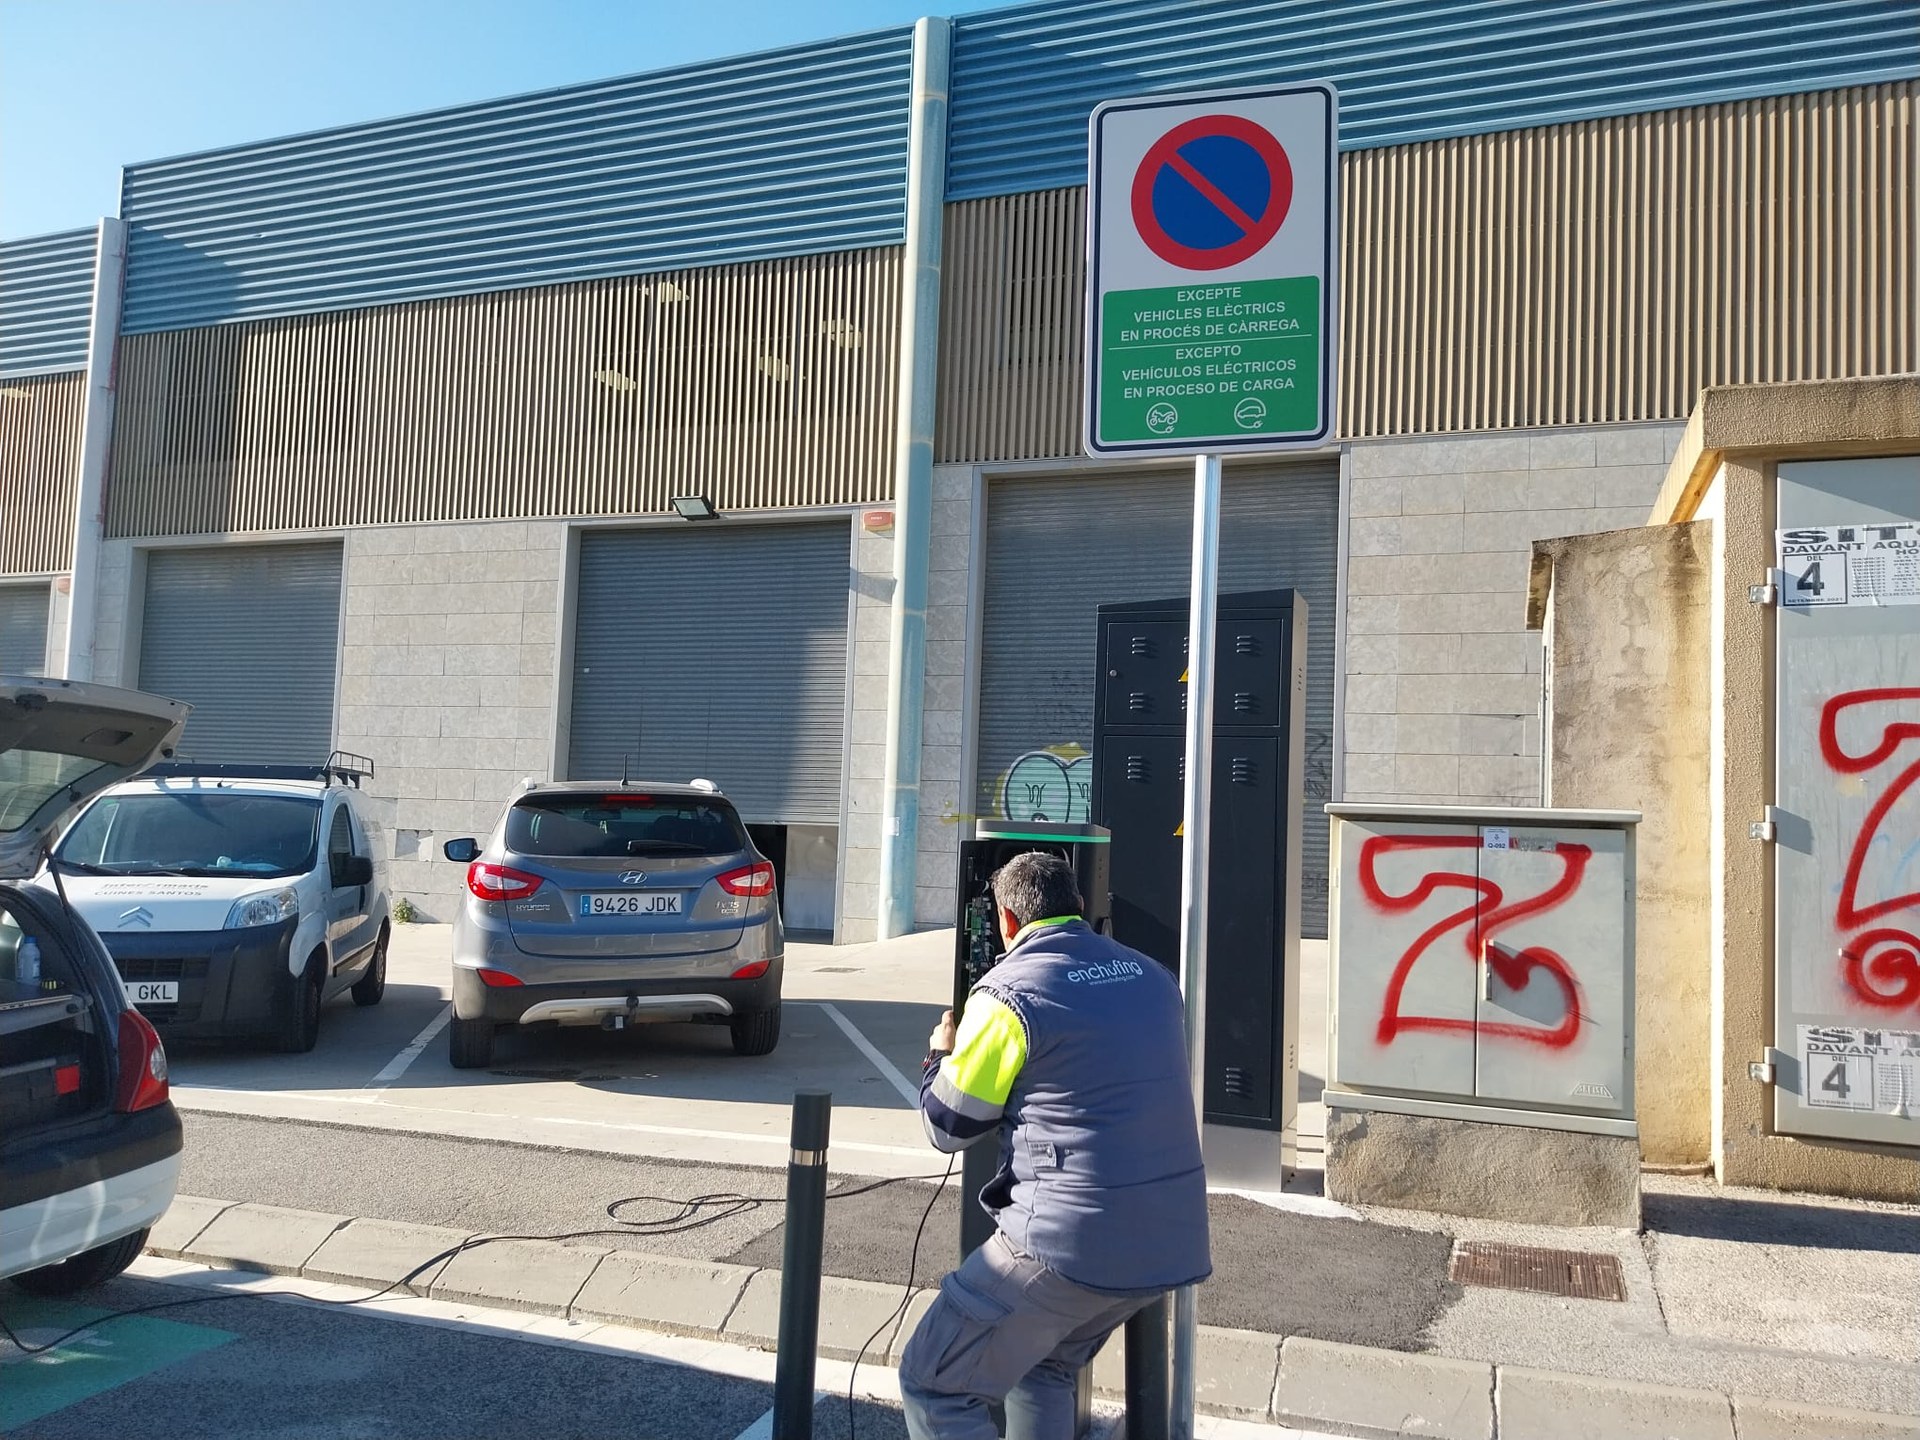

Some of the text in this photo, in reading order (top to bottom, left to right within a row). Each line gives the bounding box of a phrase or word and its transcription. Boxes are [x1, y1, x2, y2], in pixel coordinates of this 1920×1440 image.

[1177, 287, 1242, 302] EXCEPTE
[1134, 301, 1286, 323] VEHICLES ELÈCTRICS
[1121, 318, 1300, 341] EN PROCÉS DE CÀRREGA
[1175, 345, 1242, 360] EXCEPTO
[1122, 359, 1297, 381] VEHÍCULOS ELÉCTRICOS
[1124, 377, 1295, 399] EN PROCESO DE CARGA
[1782, 525, 1920, 544] SIT
[1782, 540, 1920, 554] DAVANT AQU
[1796, 561, 1825, 596] 4
[594, 896, 678, 913] 9426 JDK
[1807, 1042, 1892, 1056] DAVANT
[1831, 1055, 1849, 1063] DEL
[1822, 1062, 1851, 1099] 4
